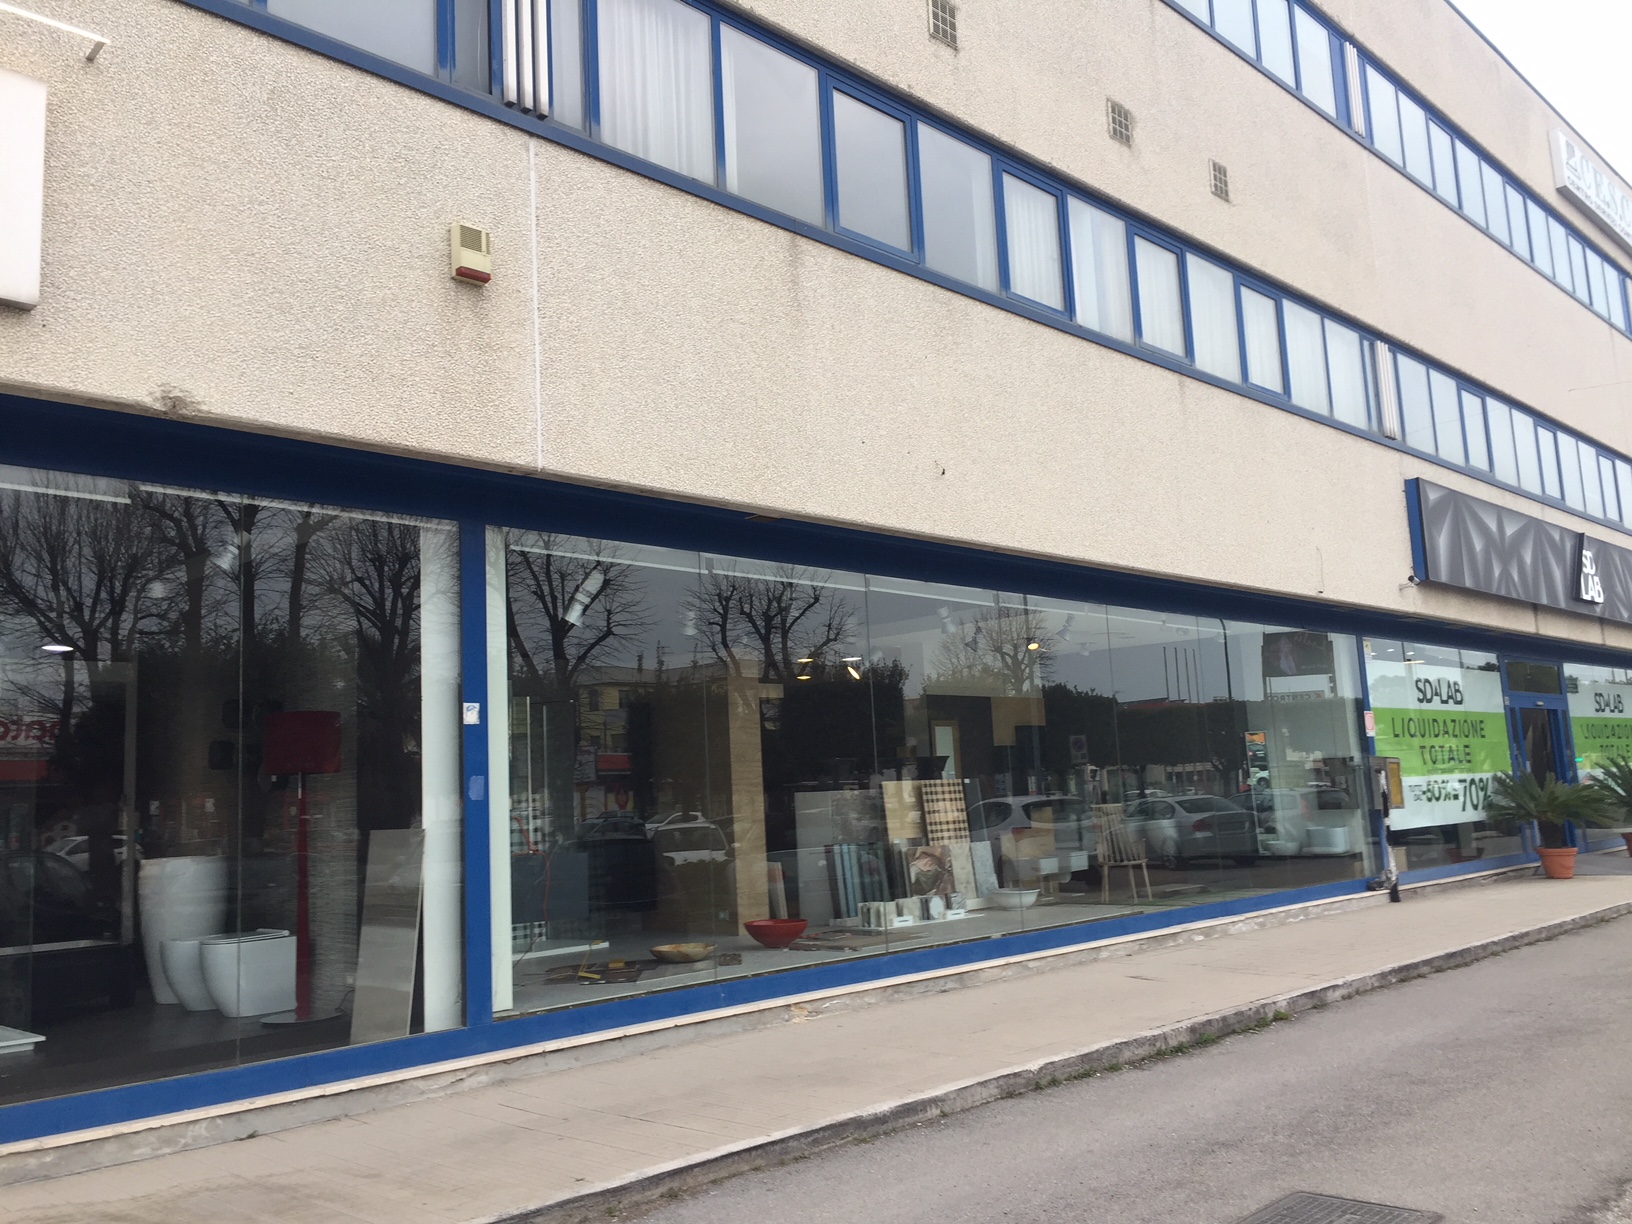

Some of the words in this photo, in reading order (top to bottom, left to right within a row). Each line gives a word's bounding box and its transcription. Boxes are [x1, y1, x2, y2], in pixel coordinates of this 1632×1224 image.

[1582, 549, 1596, 575] SD
[1580, 572, 1604, 603] LAB
[1391, 716, 1486, 739] LIQUIDAZIONE
[1419, 744, 1472, 765] TOTALE
